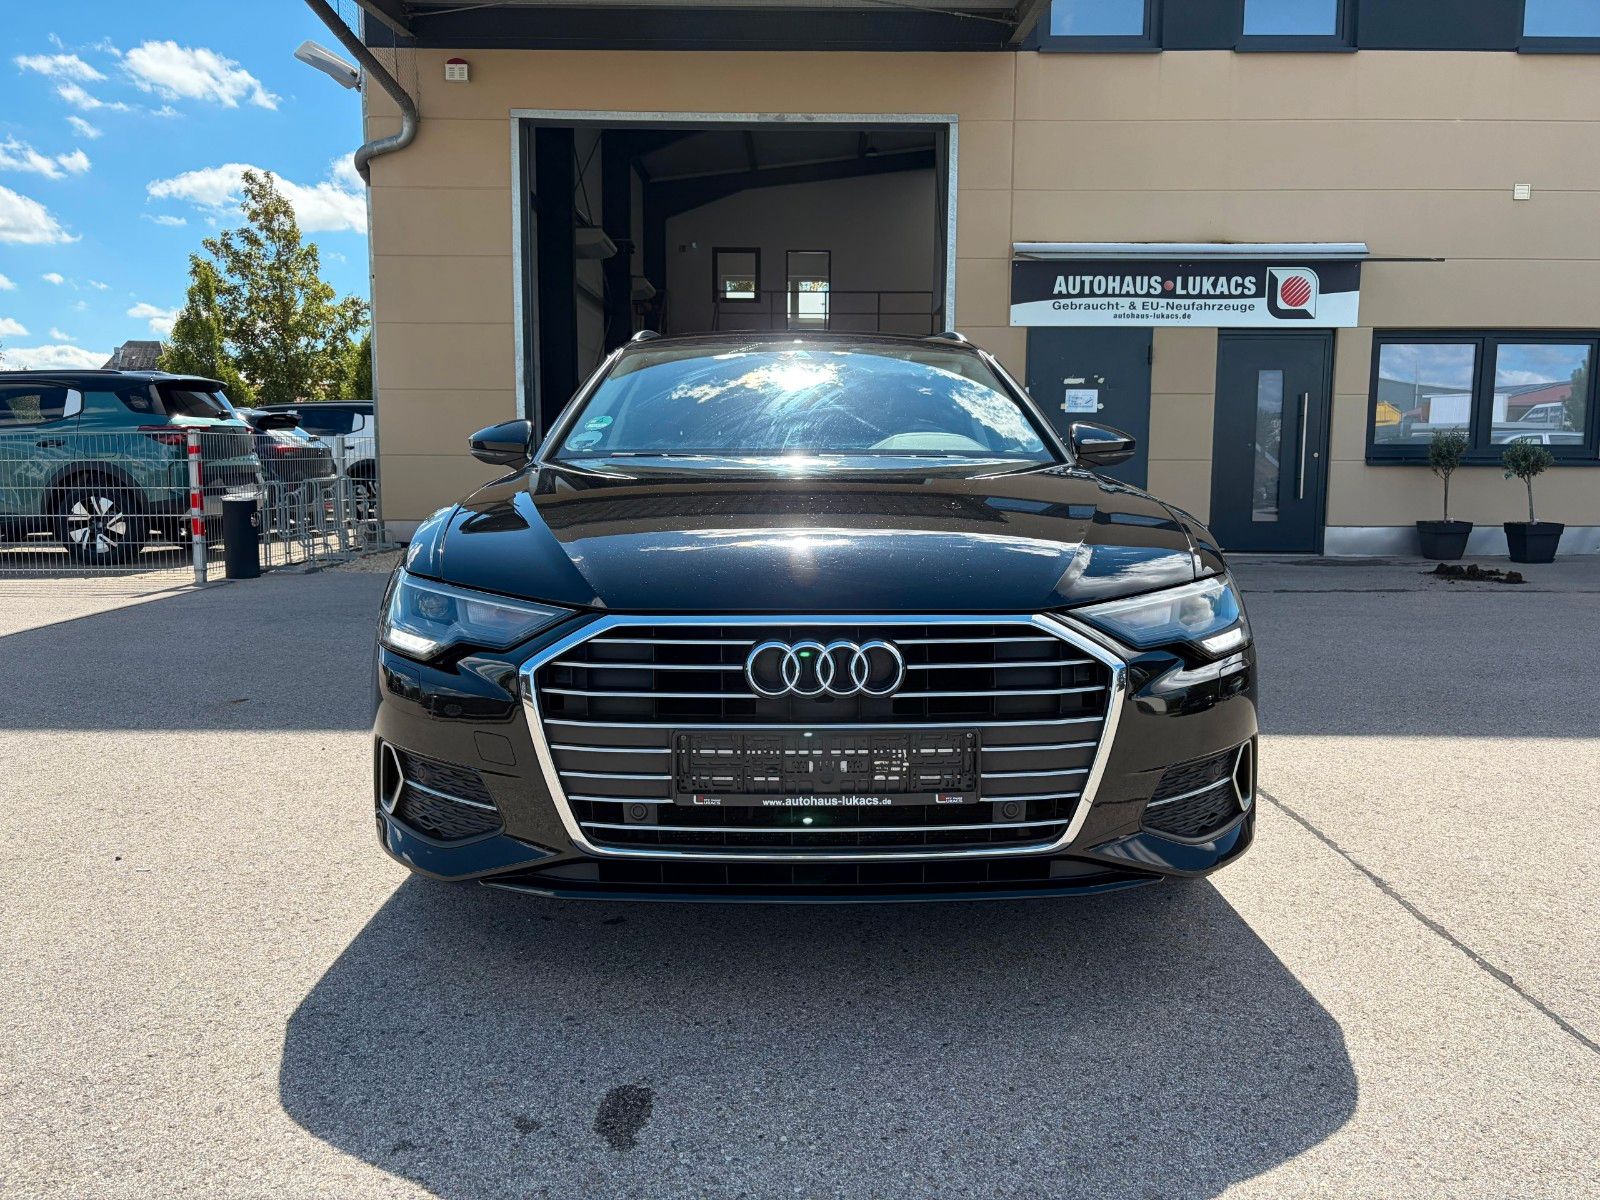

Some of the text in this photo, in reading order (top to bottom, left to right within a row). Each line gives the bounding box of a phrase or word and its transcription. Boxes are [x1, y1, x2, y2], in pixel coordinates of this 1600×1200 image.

[1052, 275, 1257, 296] AUTOHAUS LUKACS
[1052, 300, 1255, 313] Gebraucht- & EU-Neufahrzeuge
[1113, 312, 1192, 320] autohaus-lukacs.de
[762, 795, 892, 806] www.autohaus-lukacs.de
